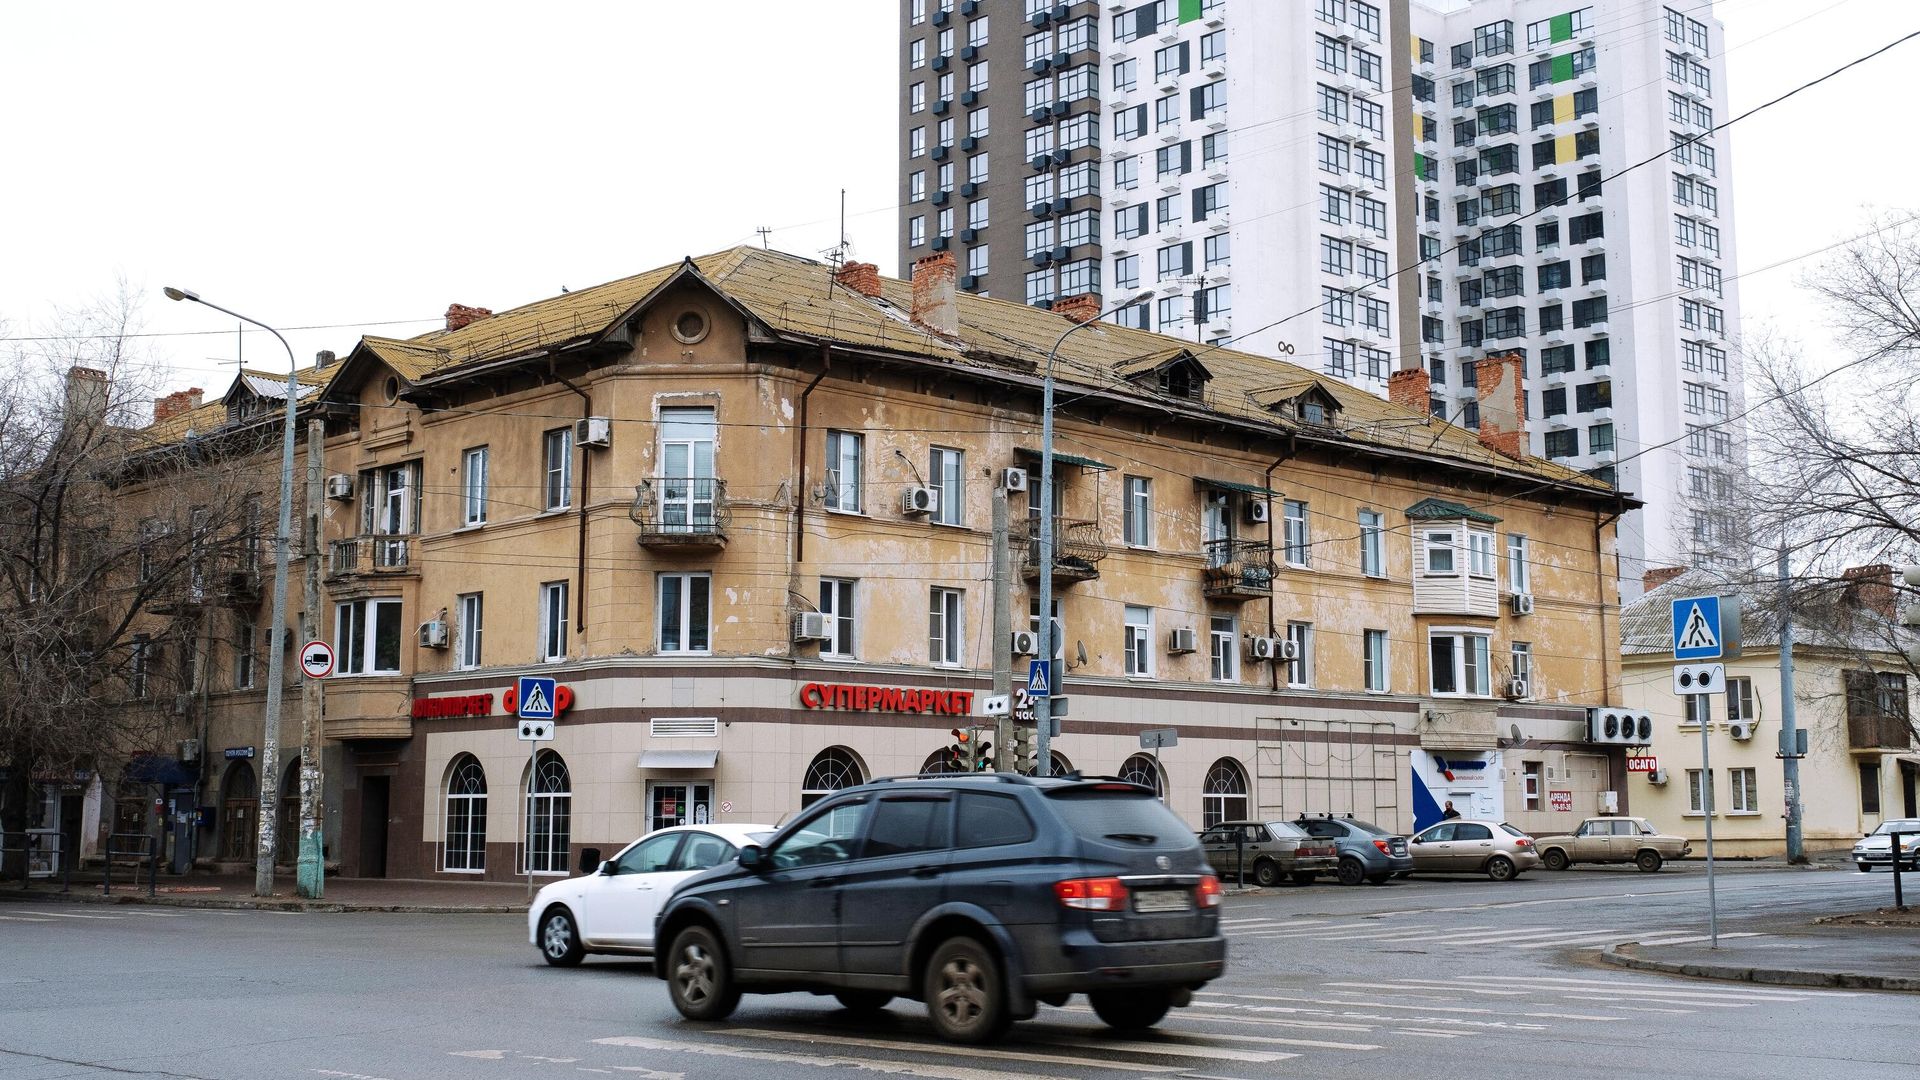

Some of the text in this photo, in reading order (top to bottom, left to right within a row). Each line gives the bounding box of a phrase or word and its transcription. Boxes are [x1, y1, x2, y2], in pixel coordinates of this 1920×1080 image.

[800, 683, 974, 715] СУПЕРМАРКЕТ
[1016, 710, 1039, 720] час
[1628, 758, 1656, 770] ОСАГО
[1550, 792, 1571, 802] АРЕНДА
